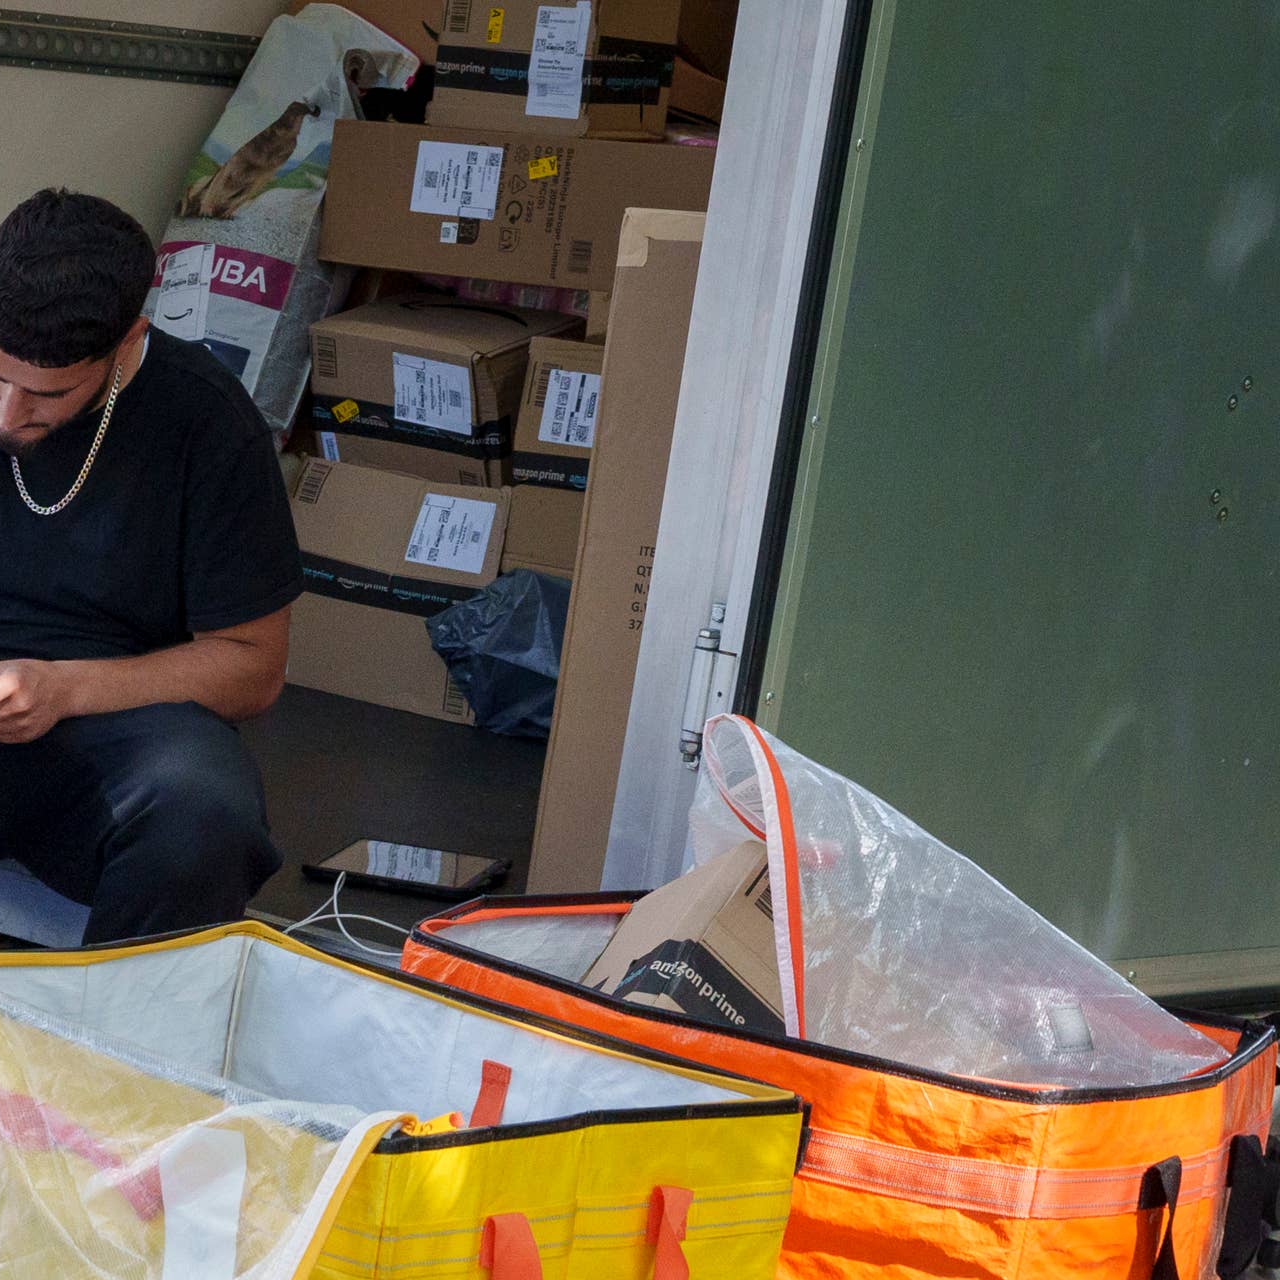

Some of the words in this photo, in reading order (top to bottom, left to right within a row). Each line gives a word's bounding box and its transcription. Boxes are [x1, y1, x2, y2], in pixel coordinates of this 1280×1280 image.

[436, 61, 461, 74] mazon
[460, 61, 486, 75] prime
[512, 466, 539, 480] mazon
[538, 469, 566, 483] prime
[639, 545, 656, 558] ITE
[636, 564, 653, 578] QT
[649, 959, 705, 988] amazon
[698, 982, 746, 1026] prime
